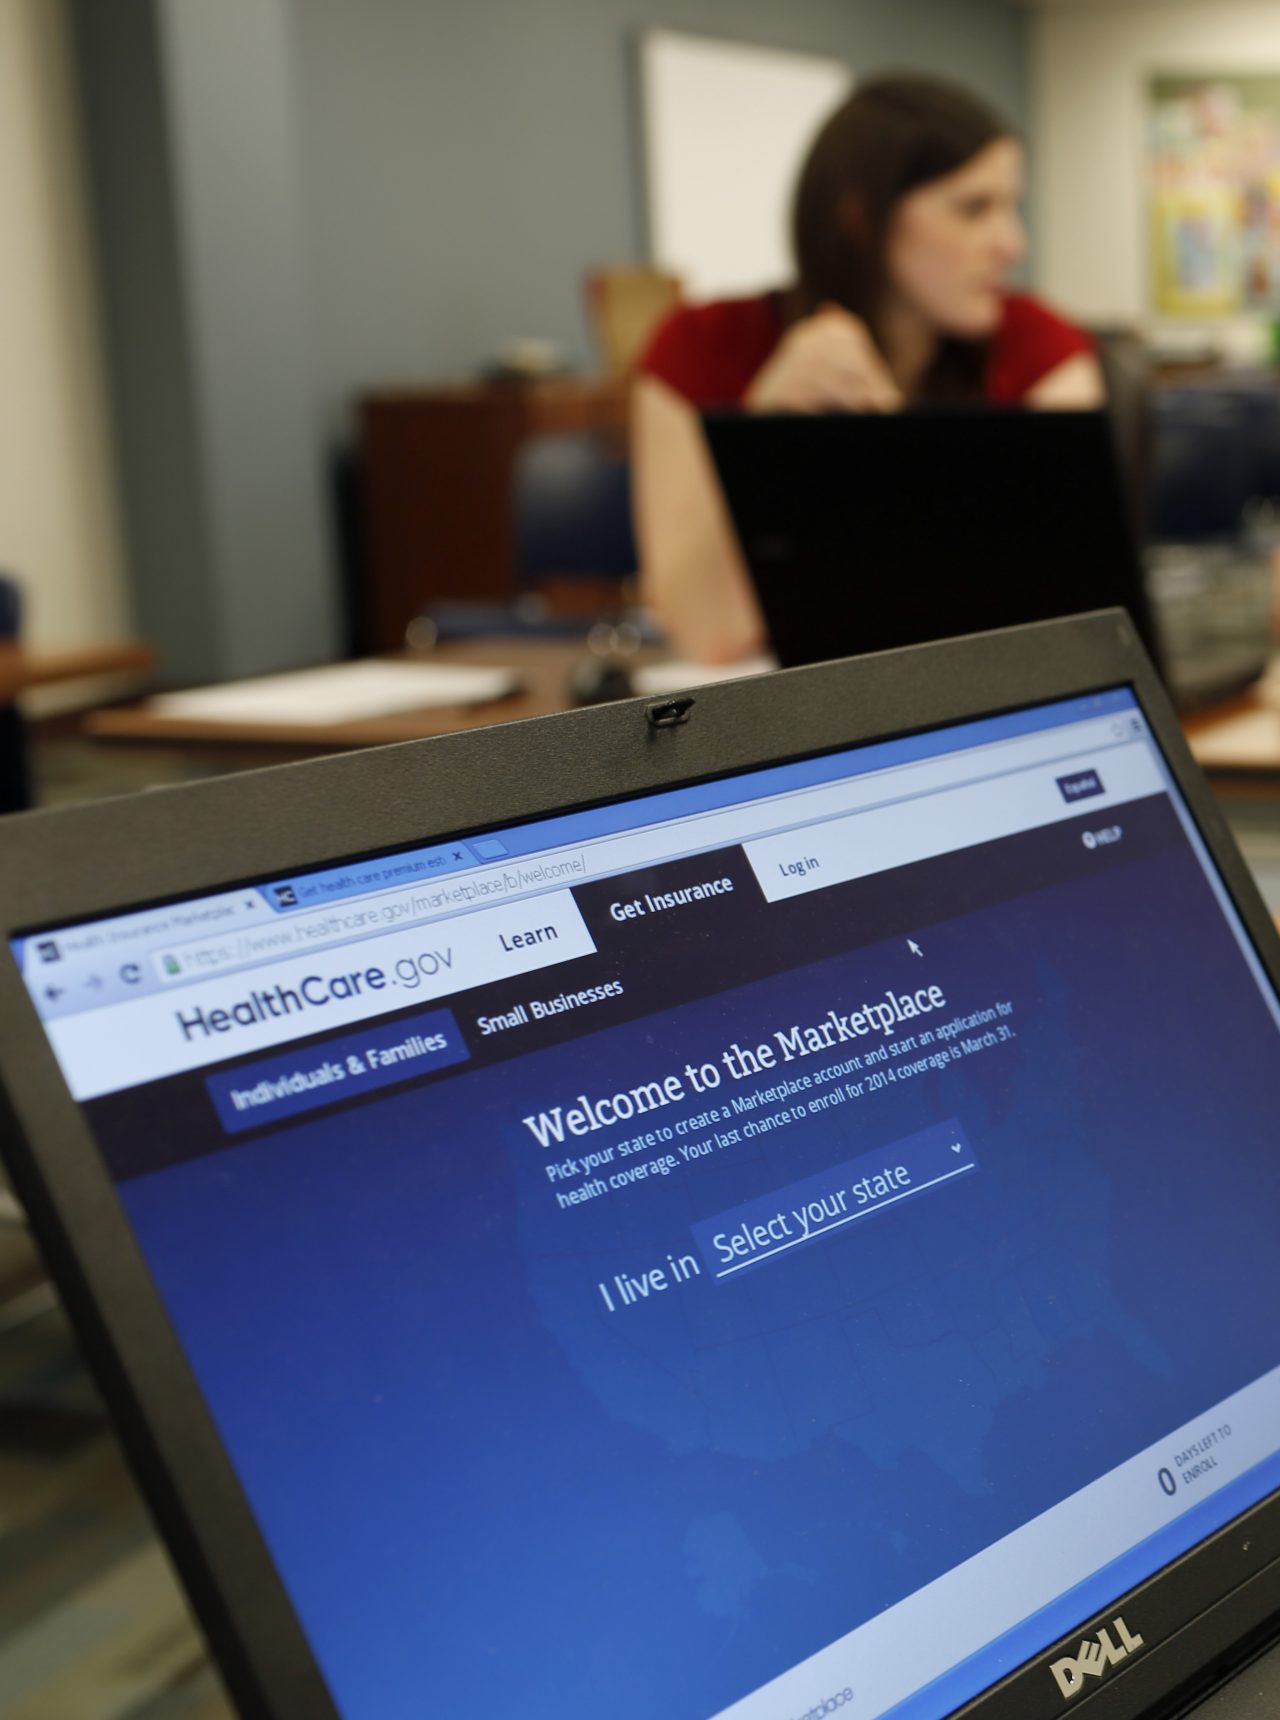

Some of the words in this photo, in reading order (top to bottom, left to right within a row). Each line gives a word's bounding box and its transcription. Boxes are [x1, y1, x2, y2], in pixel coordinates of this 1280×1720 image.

[320, 873, 355, 894] health
[356, 870, 381, 885] care
[383, 862, 426, 881] premium
[610, 898, 646, 922] Get
[645, 875, 734, 913] Insurance
[499, 924, 558, 952] Learn
[175, 947, 453, 1041] HealthCare.gov
[477, 1005, 529, 1036] Small
[529, 980, 625, 1021] Businesses
[229, 1061, 347, 1111] Individuals
[346, 1055, 367, 1076] &
[365, 1032, 448, 1069] Families
[522, 1075, 686, 1148] Welcome
[684, 1063, 721, 1094] to
[722, 1043, 778, 1080] the
[773, 984, 947, 1063] Marketplace
[545, 1158, 581, 1183] Pick
[578, 1147, 615, 1176] your
[617, 1133, 657, 1157] state
[655, 1126, 674, 1143] to
[675, 1109, 721, 1136] create
[722, 1105, 732, 1119] a
[730, 1075, 813, 1115] Marketplace
[812, 1055, 864, 1085] account
[863, 1044, 889, 1066] and
[888, 1036, 919, 1057] start
[919, 1031, 936, 1046] an
[935, 1007, 998, 1041] application
[995, 1001, 1014, 1016] for
[555, 1178, 609, 1209] health
[608, 1153, 681, 1190] coverage.
[678, 1138, 713, 1161] Your
[713, 1128, 743, 1149] last
[743, 1110, 792, 1138] chance
[791, 1105, 807, 1120] to
[808, 1088, 847, 1113] enroll
[845, 1081, 865, 1099] for
[864, 1068, 897, 1092] 2014
[897, 1050, 951, 1080] coverage
[948, 1045, 962, 1060] is
[959, 1032, 998, 1056] March
[712, 1212, 793, 1264] Select
[791, 1188, 849, 1239] your
[852, 1165, 912, 1205] state
[599, 1282, 616, 1312] I
[614, 1267, 668, 1306] live
[666, 1254, 701, 1283] in
[1174, 1444, 1200, 1468] DAYS
[1197, 1431, 1219, 1453] LEFT
[1216, 1423, 1232, 1440] TO
[1182, 1455, 1219, 1485] ENROLL
[1157, 1466, 1177, 1496] 0
[1049, 1616, 1145, 1700] DELL
